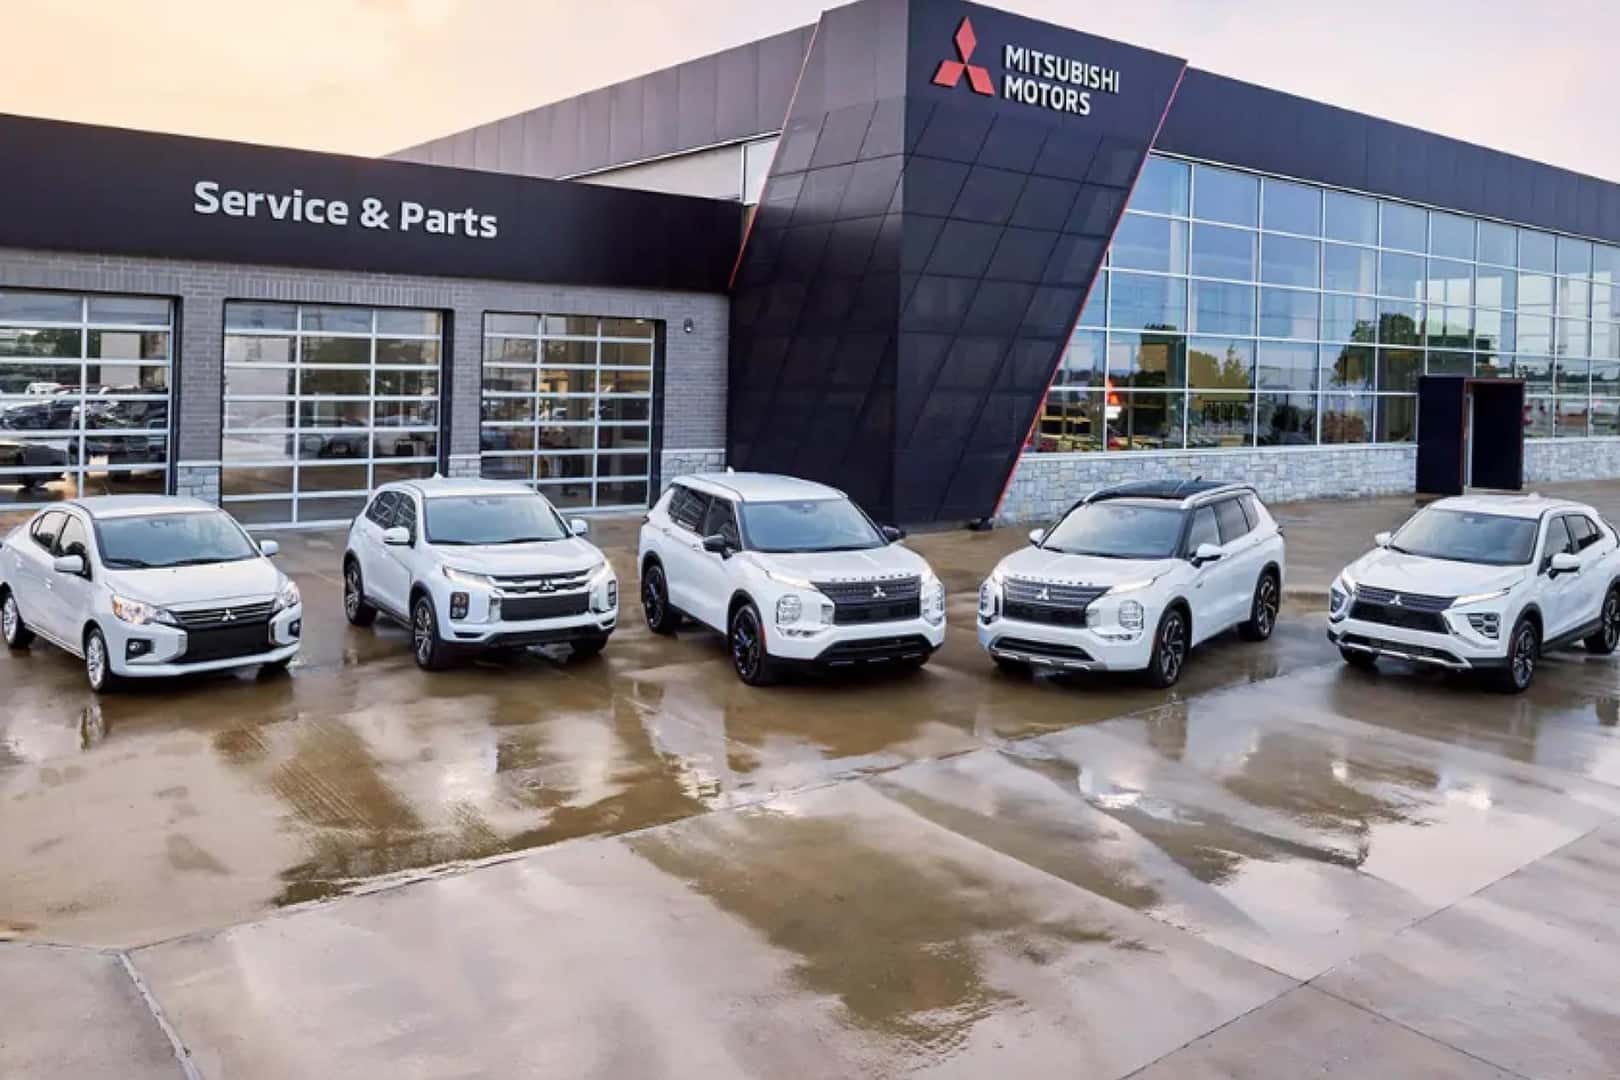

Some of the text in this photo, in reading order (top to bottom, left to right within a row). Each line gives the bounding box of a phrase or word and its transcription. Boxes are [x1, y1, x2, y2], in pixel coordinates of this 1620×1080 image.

[1005, 45, 1120, 93] MITSUBISHI
[1005, 76, 1091, 115] MOTORS
[194, 181, 498, 238] Service & Parts
